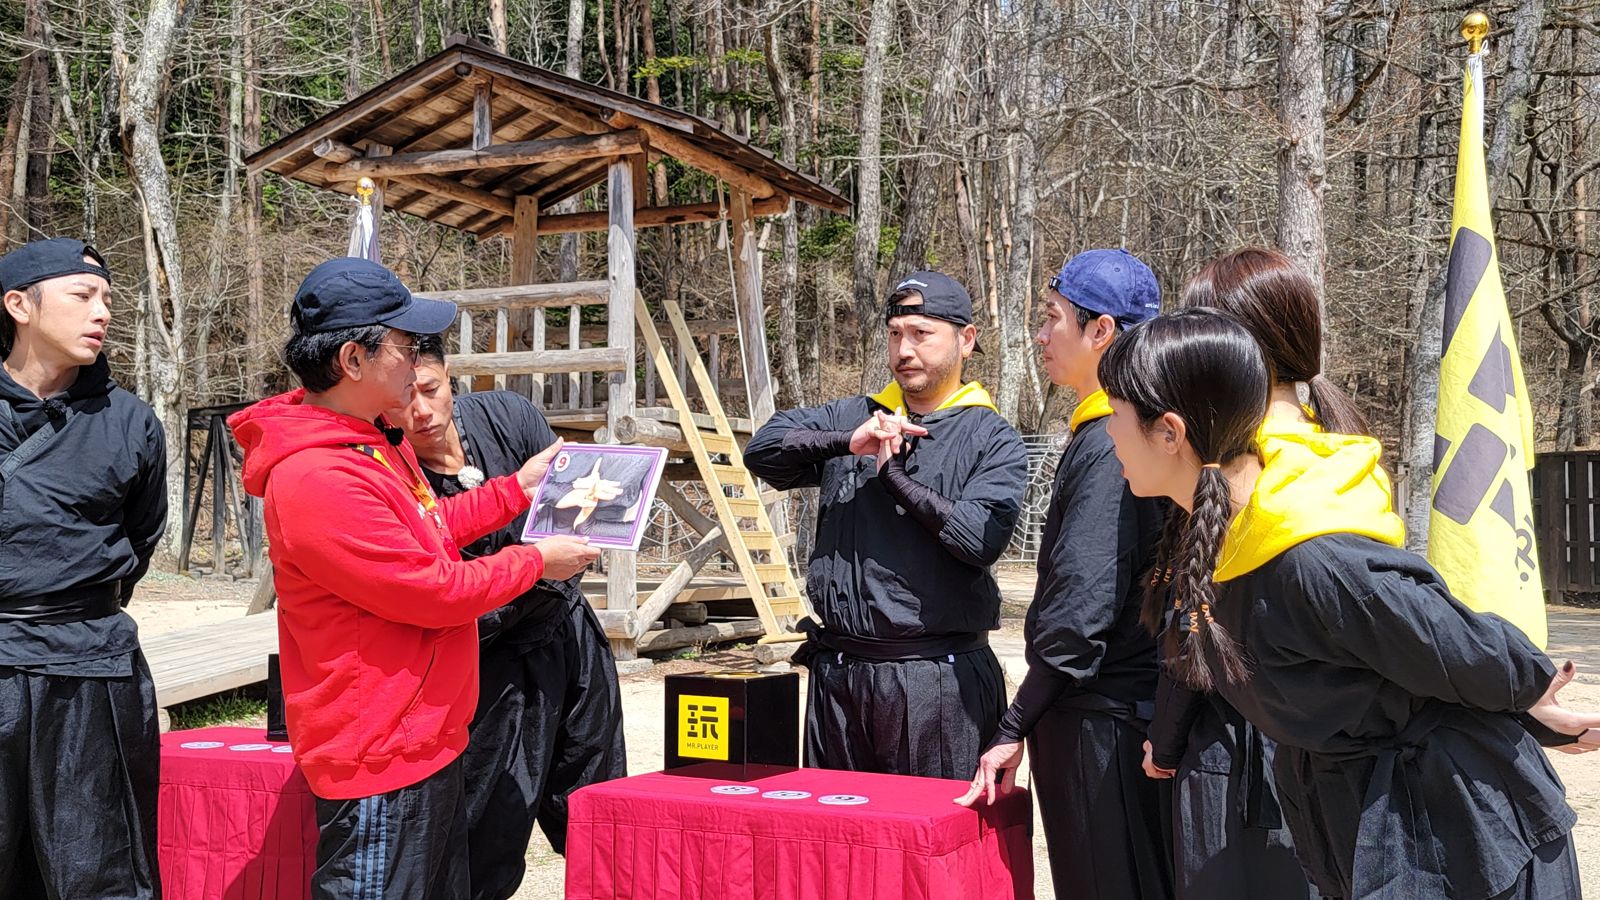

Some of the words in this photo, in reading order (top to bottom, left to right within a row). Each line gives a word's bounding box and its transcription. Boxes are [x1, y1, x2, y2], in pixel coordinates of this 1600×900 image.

[558, 456, 567, 469] 9
[687, 705, 719, 740] 玩
[687, 742, 719, 751] MR.PLAYER
